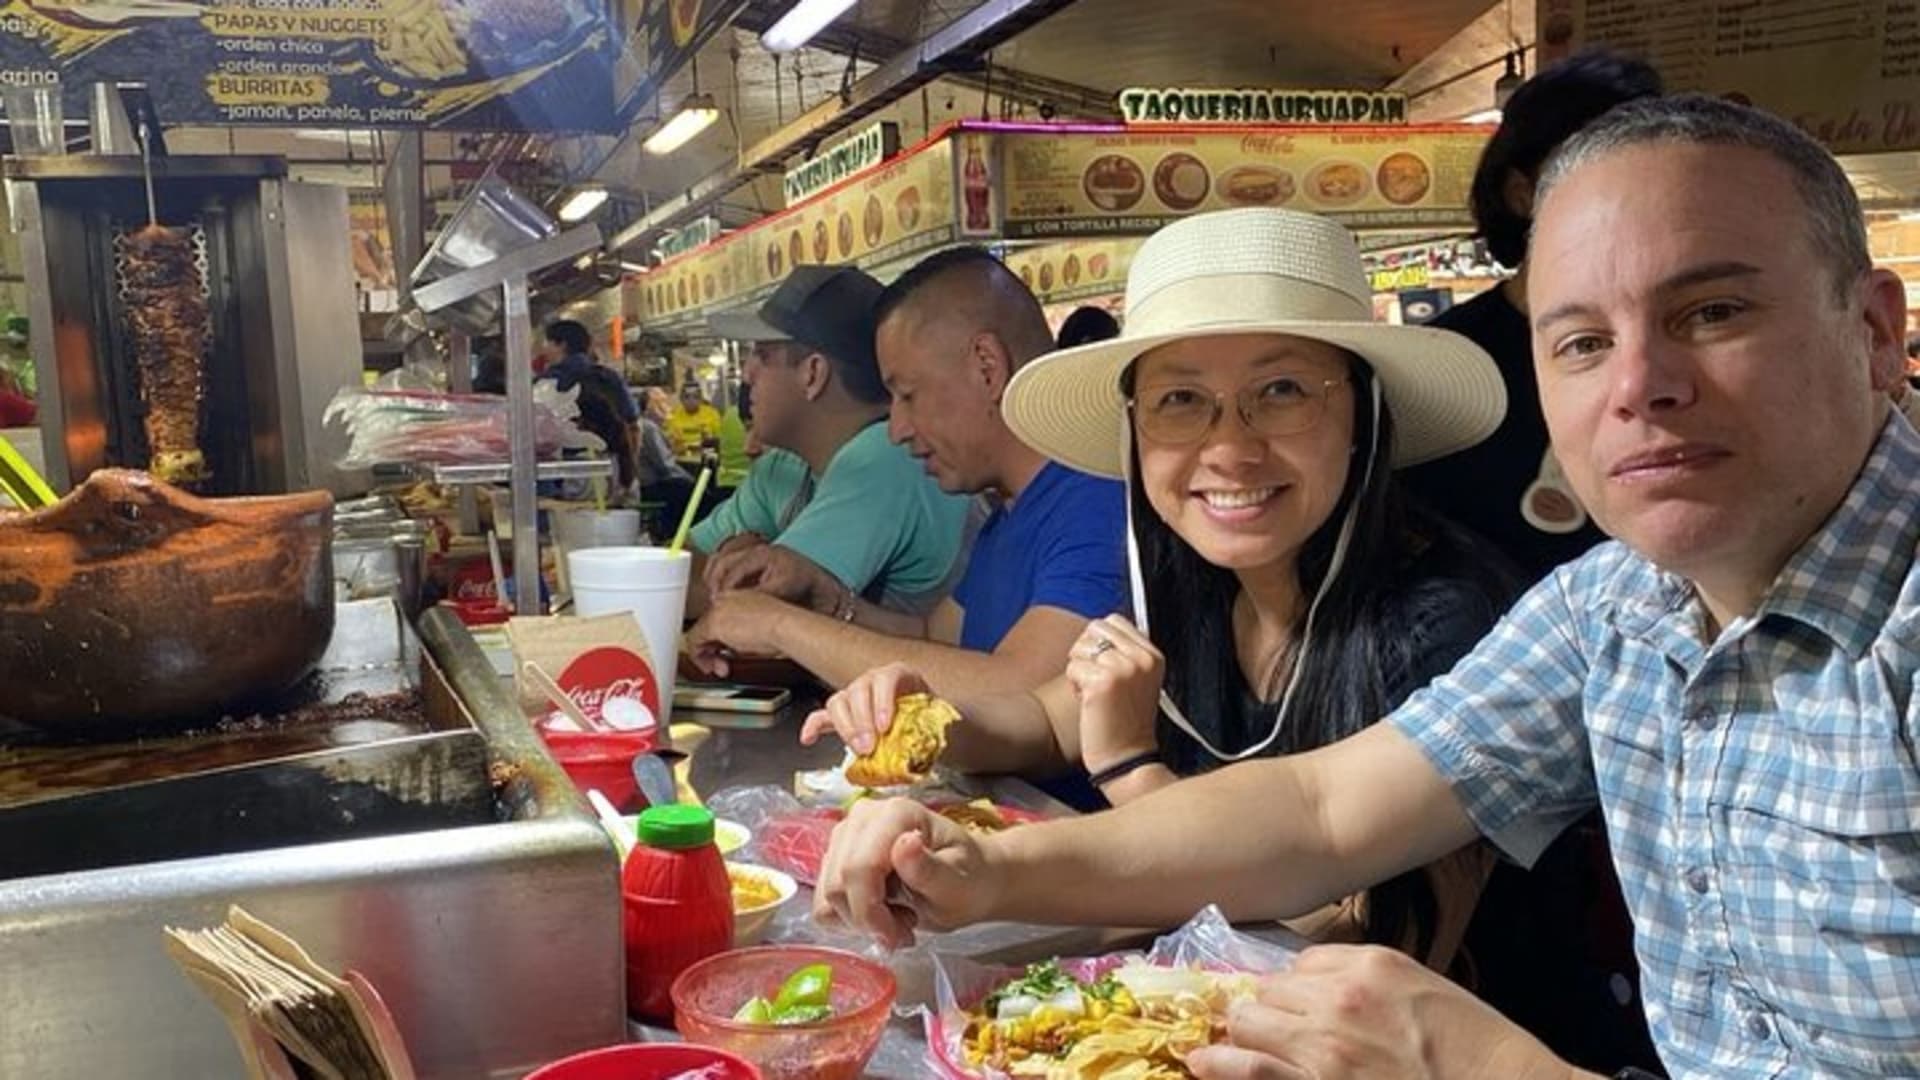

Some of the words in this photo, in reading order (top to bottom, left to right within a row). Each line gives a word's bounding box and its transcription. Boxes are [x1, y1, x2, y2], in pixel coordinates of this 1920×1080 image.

[213, 13, 279, 30] PAPAS
[280, 16, 298, 30] Y
[300, 17, 389, 34] NUGGETS
[279, 39, 325, 55] chica
[218, 78, 315, 98] BURRITAS
[370, 108, 428, 124] pierna
[1064, 217, 1117, 231] TORTILLA
